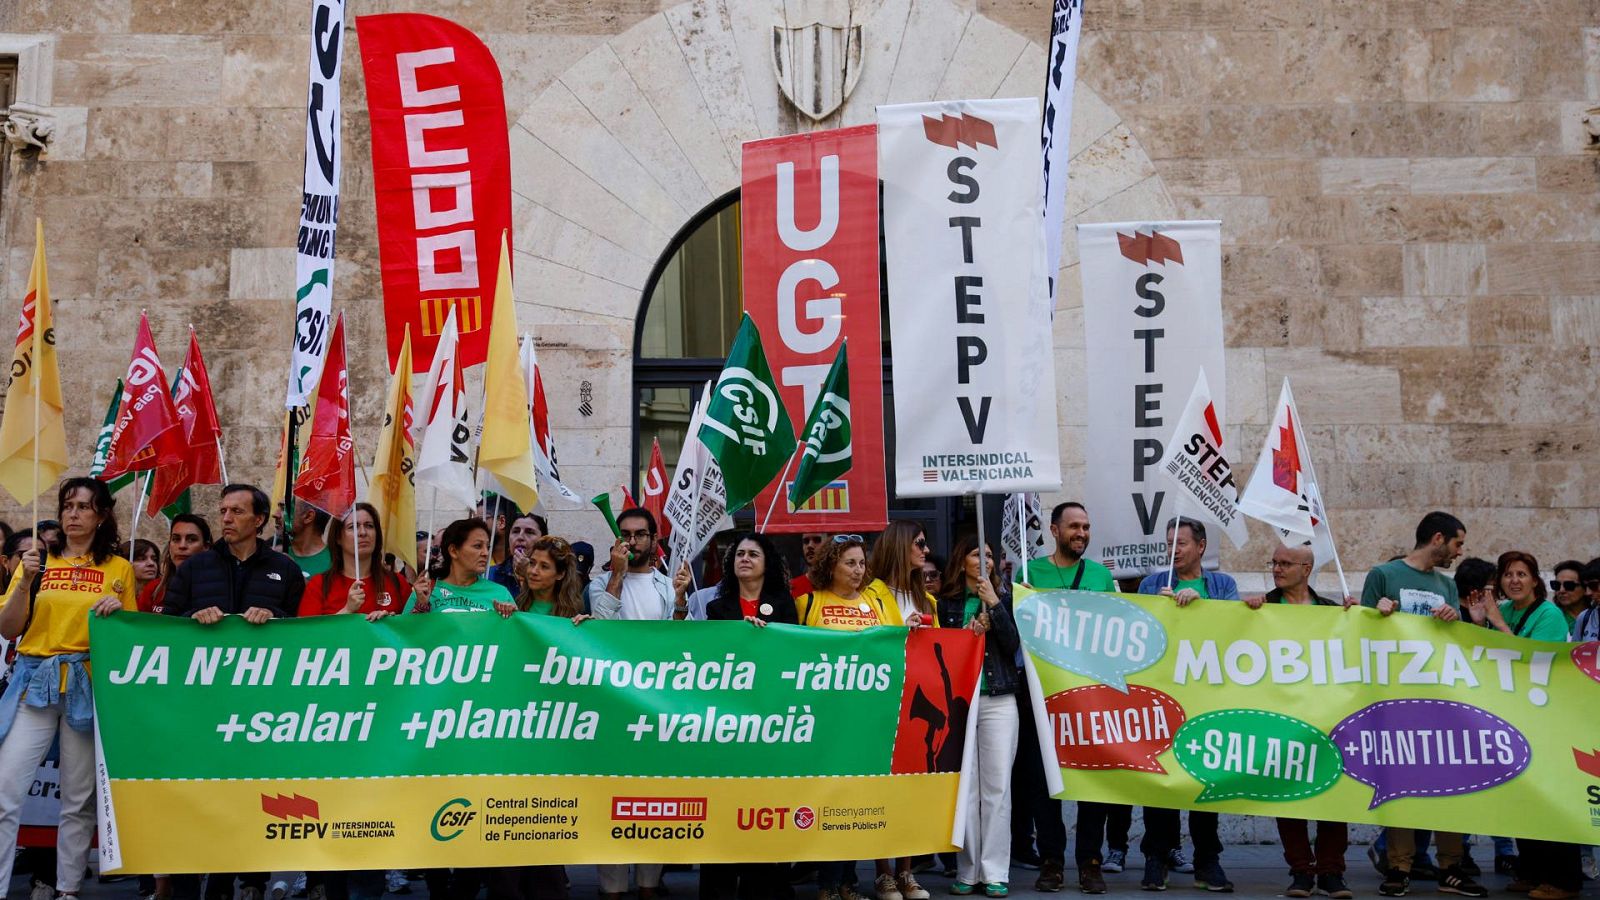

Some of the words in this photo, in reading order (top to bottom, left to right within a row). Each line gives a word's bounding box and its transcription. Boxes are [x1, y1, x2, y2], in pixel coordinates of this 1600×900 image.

[396, 46, 480, 292] CCOO
[946, 156, 993, 445] STEPV
[1132, 272, 1166, 536] STEPV
[720, 383, 767, 456] CSIF
[922, 452, 1033, 468] INTERSINDICAL
[940, 466, 1034, 482] VALENCIANA
[1174, 451, 1238, 520] INTERSINDICAL
[1177, 470, 1231, 528] VALENCIANA
[40, 582, 103, 594] ducació
[1022, 599, 1149, 663] -RÀTIOS
[109, 645, 170, 685] JA
[184, 646, 283, 686] N'HI
[291, 648, 351, 686] HA
[365, 644, 499, 686] PROU!
[523, 647, 756, 691] -burocràcia
[781, 652, 891, 692] -ràtios
[1173, 638, 1557, 706] MOBILITZA'T!
[216, 703, 377, 743] +salari
[400, 700, 600, 749] +plantilla
[626, 704, 816, 744] +valencià
[1186, 729, 1318, 784] +SALARI
[1344, 729, 1514, 766] +PLANTILLES
[486, 798, 527, 809] Central
[531, 798, 578, 809] Sindical
[616, 801, 677, 817] CCOO
[823, 806, 885, 819] Ensenyament
[332, 821, 396, 830] INTERSINDICAL
[439, 811, 477, 827] CSIF
[485, 814, 567, 826] Independiente
[571, 816, 579, 828] y
[737, 807, 791, 831] UGT
[822, 822, 851, 831] Serveis
[852, 821, 878, 831] Públics
[878, 820, 888, 828] PV
[265, 822, 329, 840] STEPV
[341, 830, 396, 839] VALENCIANA
[485, 831, 500, 841] de
[503, 830, 579, 841] Funcionarios
[611, 822, 705, 840] educació
